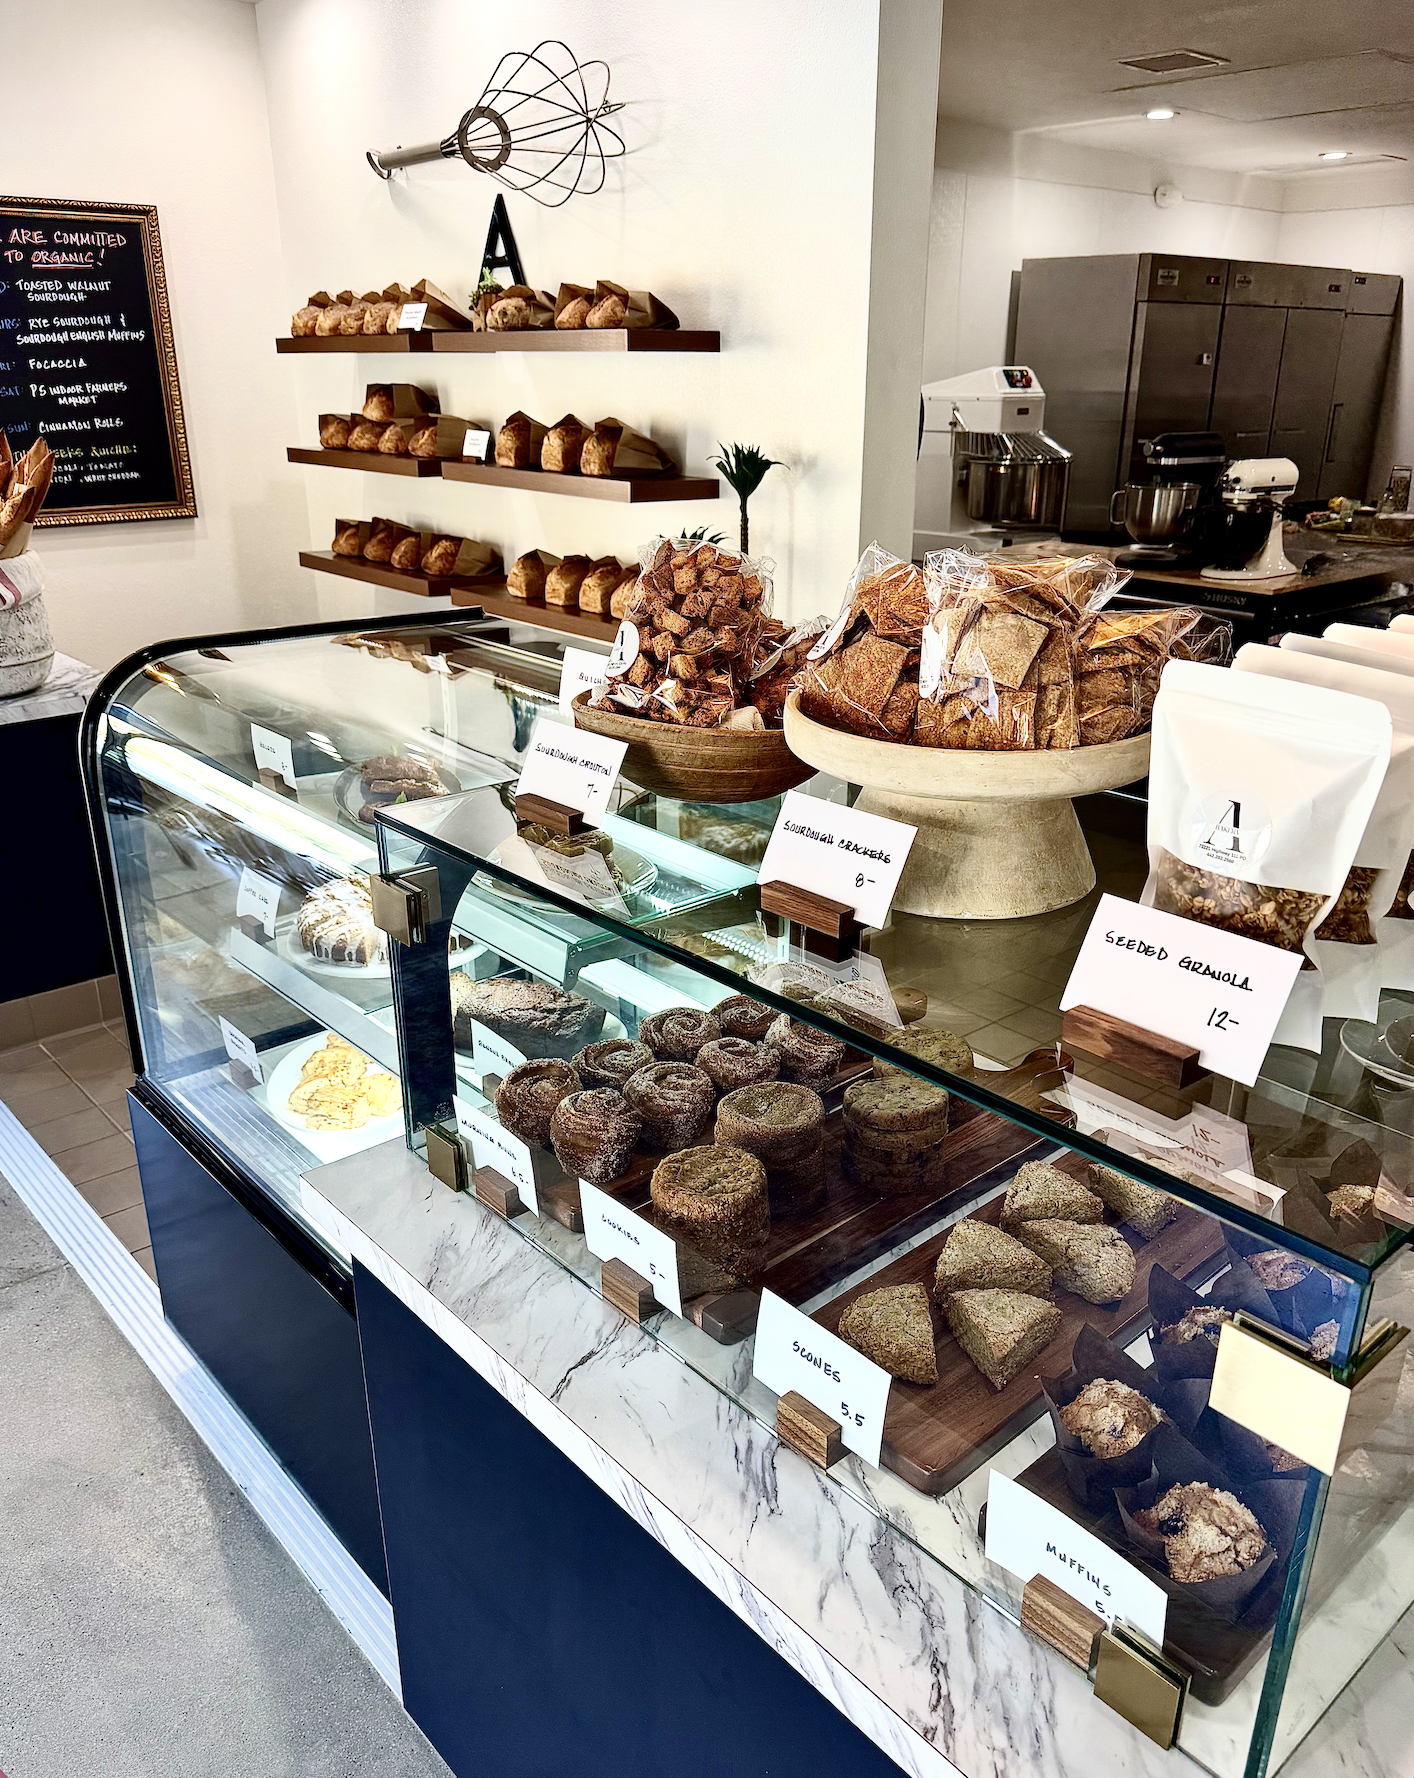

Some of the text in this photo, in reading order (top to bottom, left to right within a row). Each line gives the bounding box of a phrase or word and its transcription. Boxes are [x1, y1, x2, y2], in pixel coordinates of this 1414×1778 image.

[8, 228, 127, 248] ARE COMMITTED
[477, 193, 528, 288] A
[3, 249, 24, 263] TO
[15, 279, 63, 291] TOASTED
[67, 280, 111, 291] WALNUT
[27, 292, 86, 302] SOURDOUGH
[28, 318, 50, 330] RYE
[52, 315, 112, 327] SOURDOUGH
[16, 329, 146, 345] SOURDOUGH ENGLISH MUFFINS
[28, 358, 87, 370] FOCACCIA
[29, 383, 47, 397] PS
[48, 385, 84, 396] INDOOR
[58, 395, 98, 407] MARKET
[7, 417, 124, 434] SUN: CINNAMON ROLLS
[535, 742, 578, 765] SOURDOUGH
[1202, 799, 1244, 854] A
[783, 820, 891, 864] SOURDOUGH CRACKERS
[1105, 931, 1253, 991] SEEDED GRANOLA
[602, 1213, 640, 1246] COOKIES
[792, 1340, 841, 1383] SCONES
[841, 1401, 866, 1427] 5.5
[1046, 1542, 1111, 1597] MUFFINS
